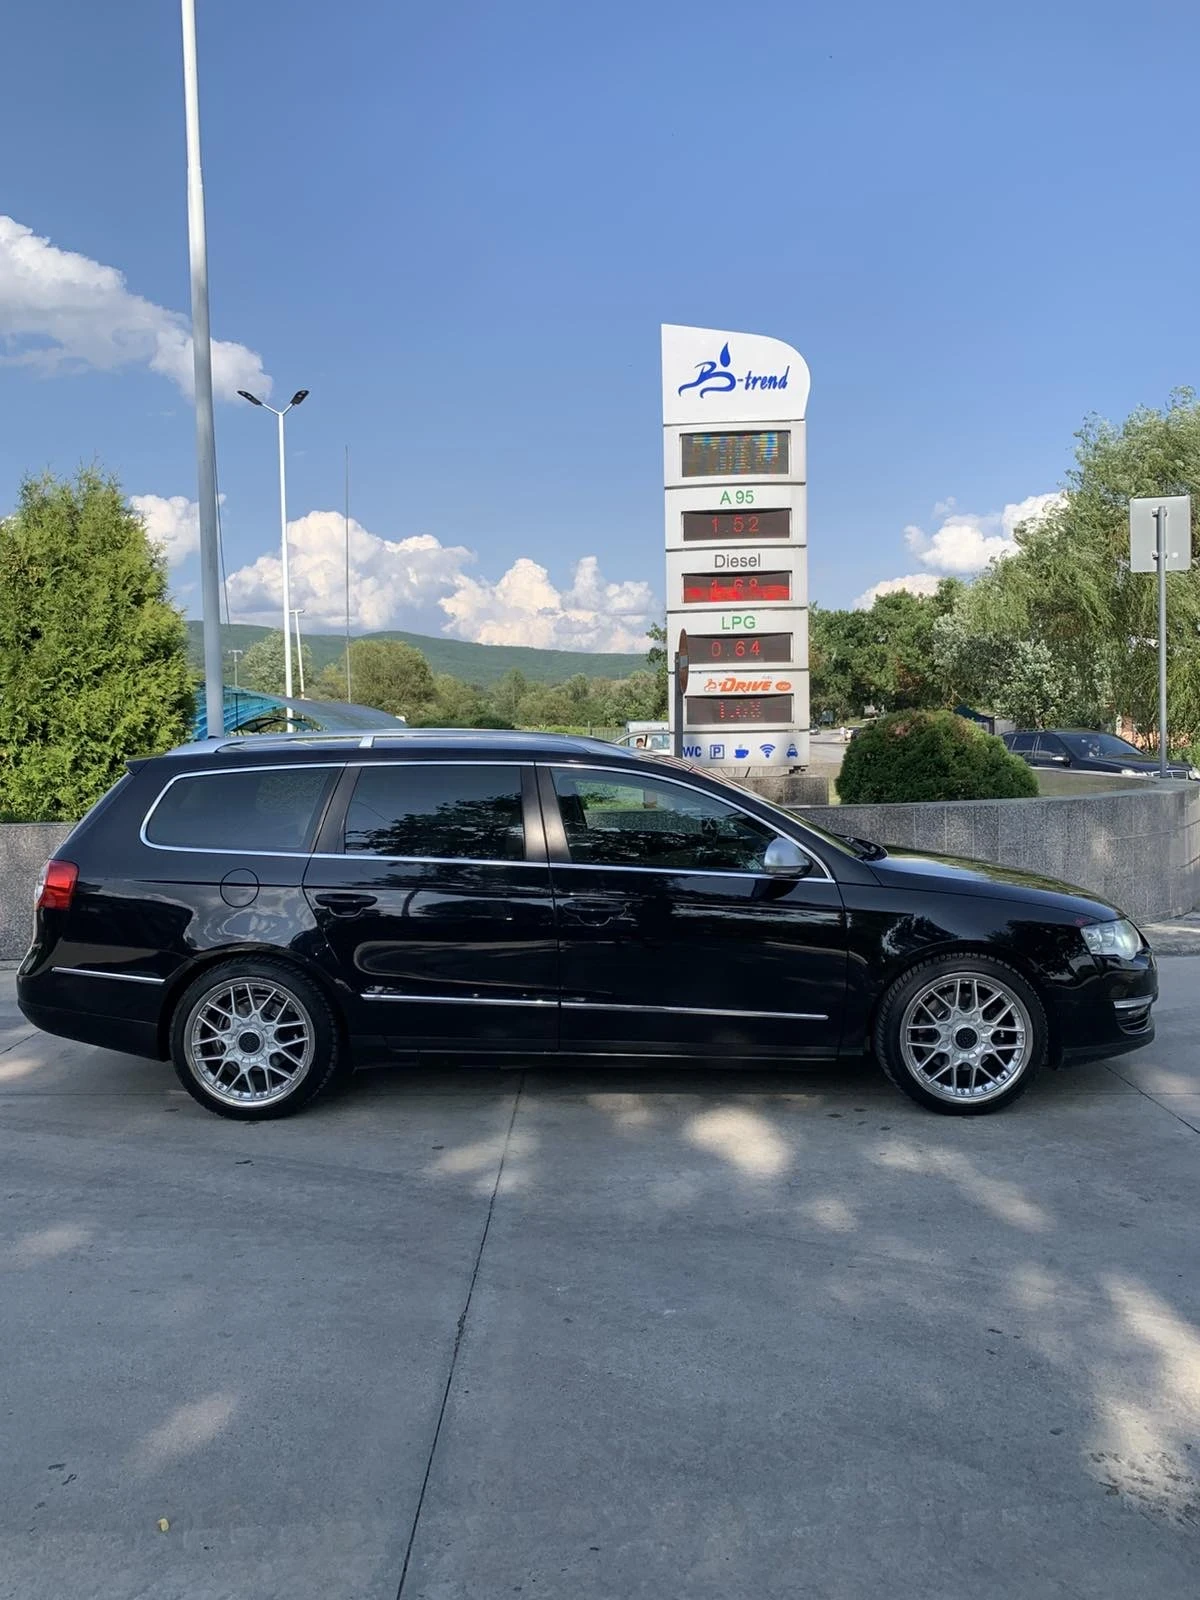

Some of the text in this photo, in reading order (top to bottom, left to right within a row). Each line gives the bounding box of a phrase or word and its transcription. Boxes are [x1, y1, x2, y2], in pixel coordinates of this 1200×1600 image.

[720, 490, 754, 505] A 95
[714, 553, 761, 568] Diesel
[721, 616, 756, 630] LPG
[683, 746, 702, 757] WC
